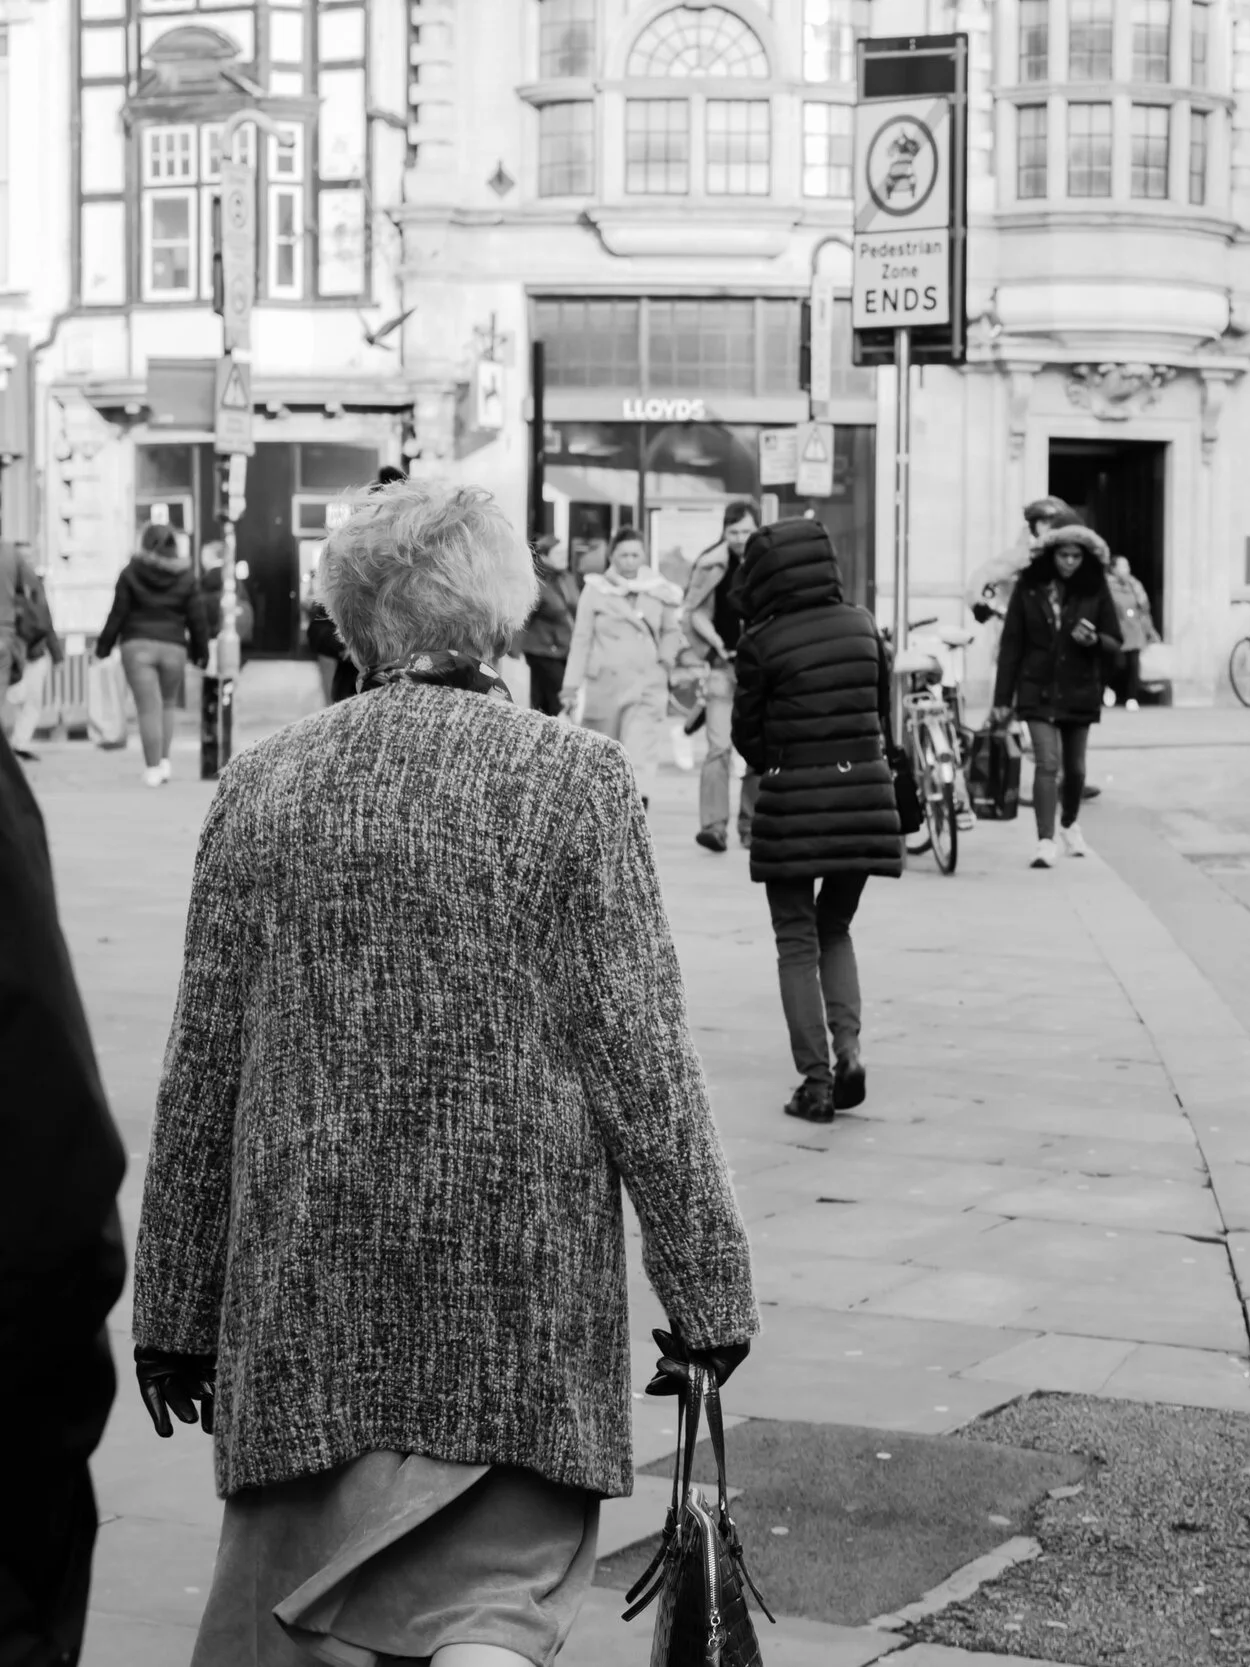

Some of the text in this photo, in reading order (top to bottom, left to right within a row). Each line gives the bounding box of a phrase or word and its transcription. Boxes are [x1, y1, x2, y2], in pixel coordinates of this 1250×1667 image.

[860, 241, 942, 258] Pedestrian
[882, 263, 918, 280] Zone
[865, 286, 937, 314] ENDS
[623, 398, 705, 421] LLOYDS
